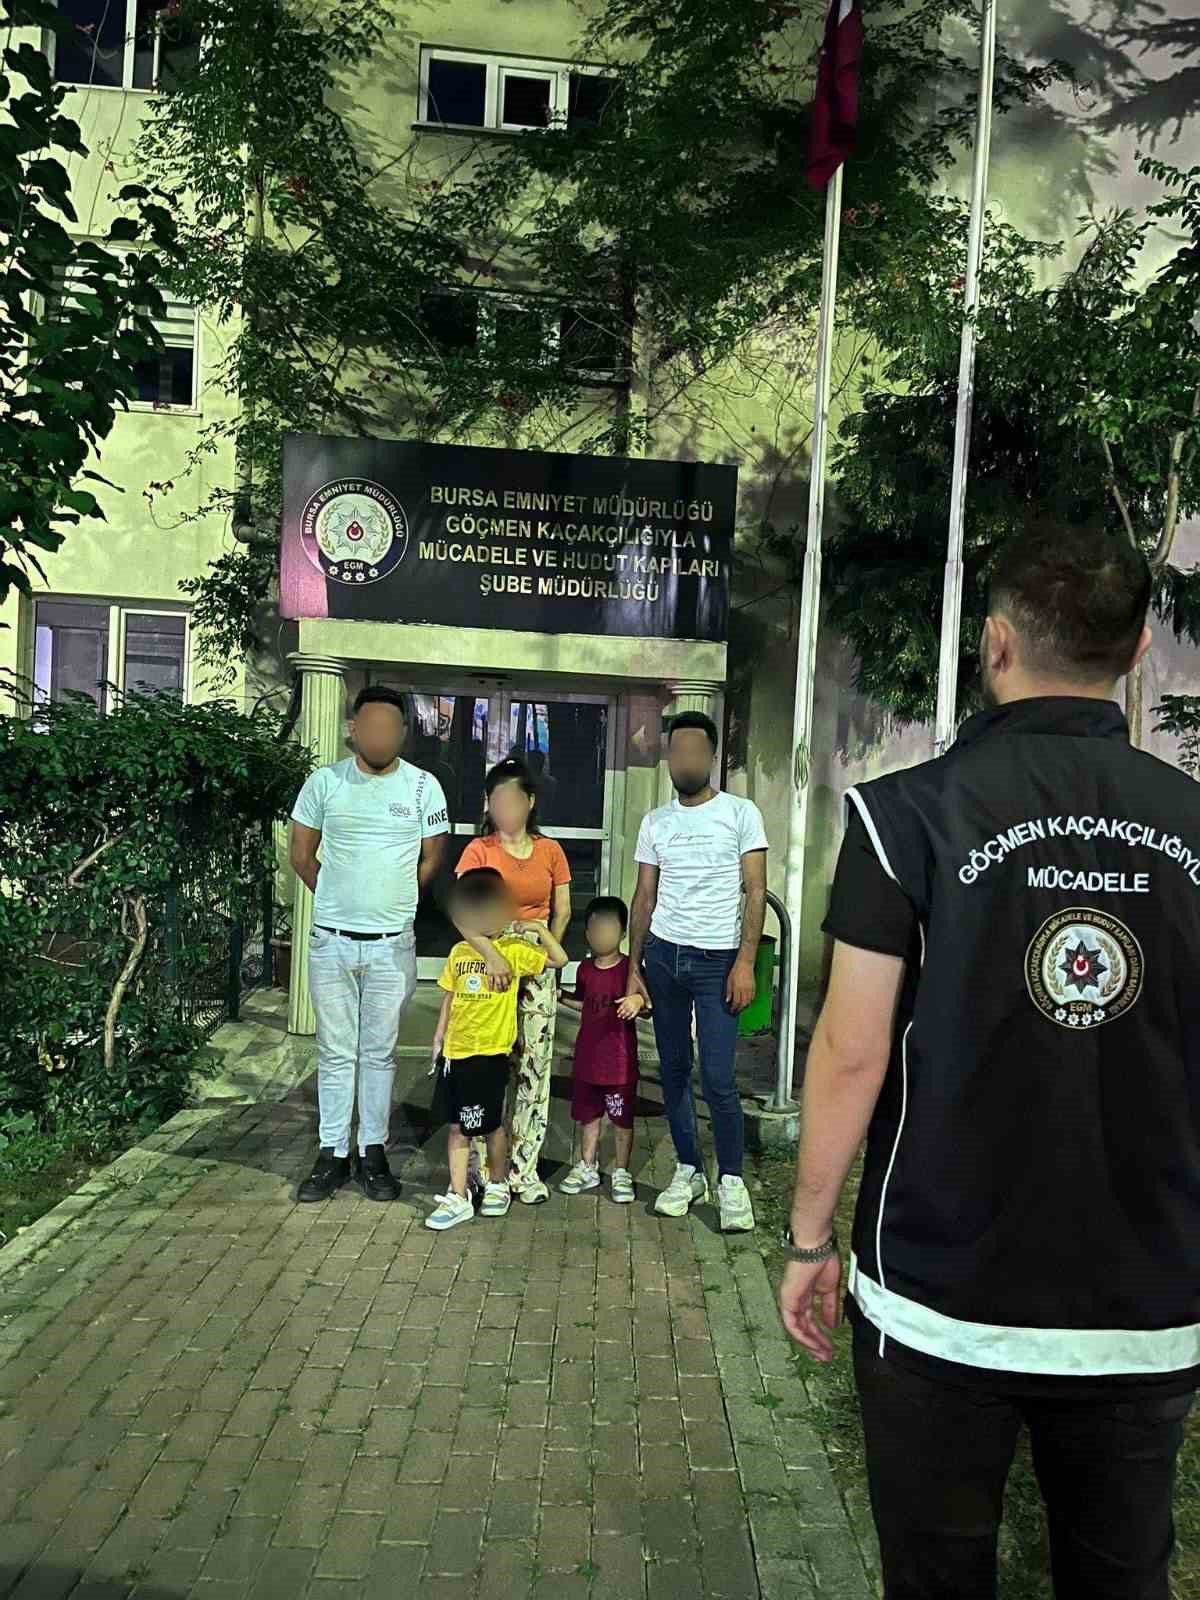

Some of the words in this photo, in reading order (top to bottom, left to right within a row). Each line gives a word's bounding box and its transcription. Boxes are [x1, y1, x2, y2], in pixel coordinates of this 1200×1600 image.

[304, 502, 320, 534] BURSA
[319, 483, 362, 502] EMNİYET
[431, 486, 498, 508] BURSA
[593, 495, 713, 522] MÜDÜRLÜĞÜ
[446, 513, 531, 539] GÖÇMEN
[537, 521, 696, 548] KAÇAKÇILIĞIYLA
[343, 561, 364, 570] EGM
[419, 539, 527, 566] MÜCADELE
[532, 549, 557, 567] VE
[633, 555, 719, 577] KAPILARI
[480, 574, 532, 596] ŞUBE
[538, 575, 659, 601] MÜDÜRLÜĞÜ
[958, 819, 1045, 885] GÖÇMEN
[1027, 866, 1150, 893] MÜCADELE
[455, 960, 489, 976] CALIFOR
[1070, 1003, 1092, 1012] EGM
